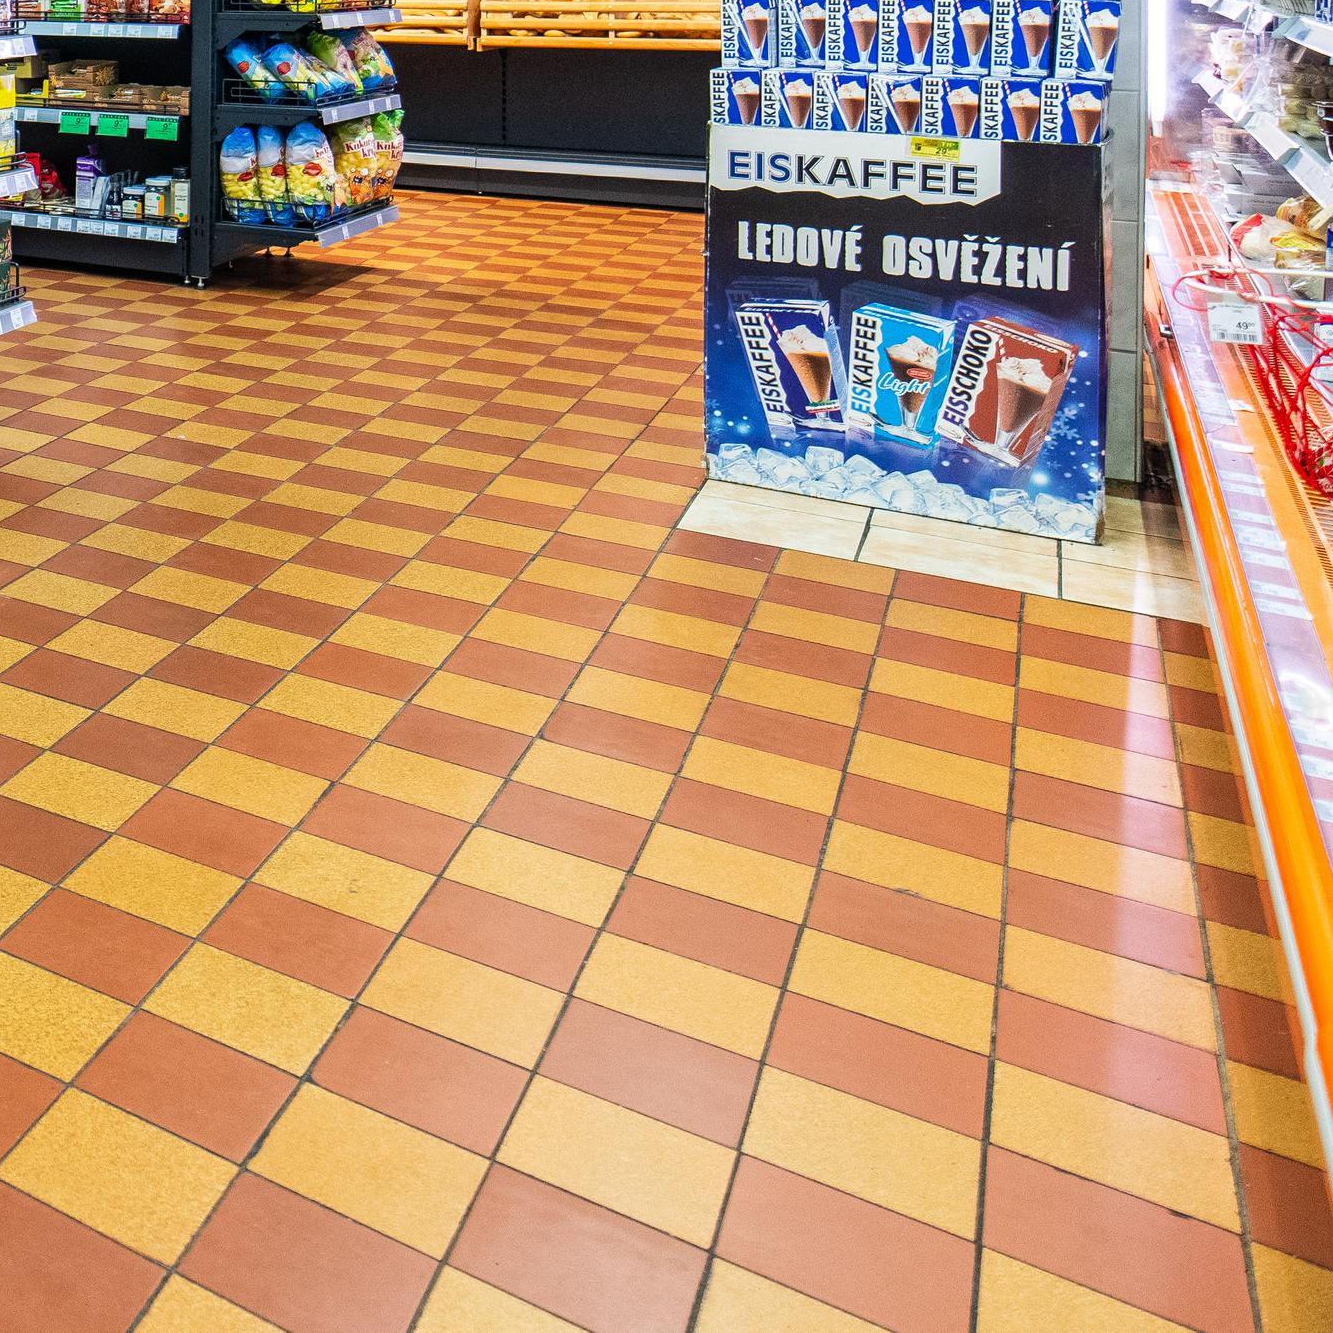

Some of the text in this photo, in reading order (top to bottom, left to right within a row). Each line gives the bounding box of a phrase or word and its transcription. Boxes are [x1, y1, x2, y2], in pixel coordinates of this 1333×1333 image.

[882, 0, 895, 63] EISKAFFEE
[937, 0, 951, 67] EISKAFFEE
[994, 0, 1009, 68] EISKAFFEE
[713, 71, 724, 123] SKAFFEE
[1044, 83, 1059, 142] SKAFFEE
[728, 149, 977, 197] EISKAFFEE
[738, 221, 1075, 292] LEDOVÉ OSVĚŽENÍ
[741, 315, 784, 413] EISKAFFEE
[852, 316, 877, 414] EISKAFFEE
[878, 372, 931, 396] Light
[944, 329, 992, 426] EISSCHOKO
